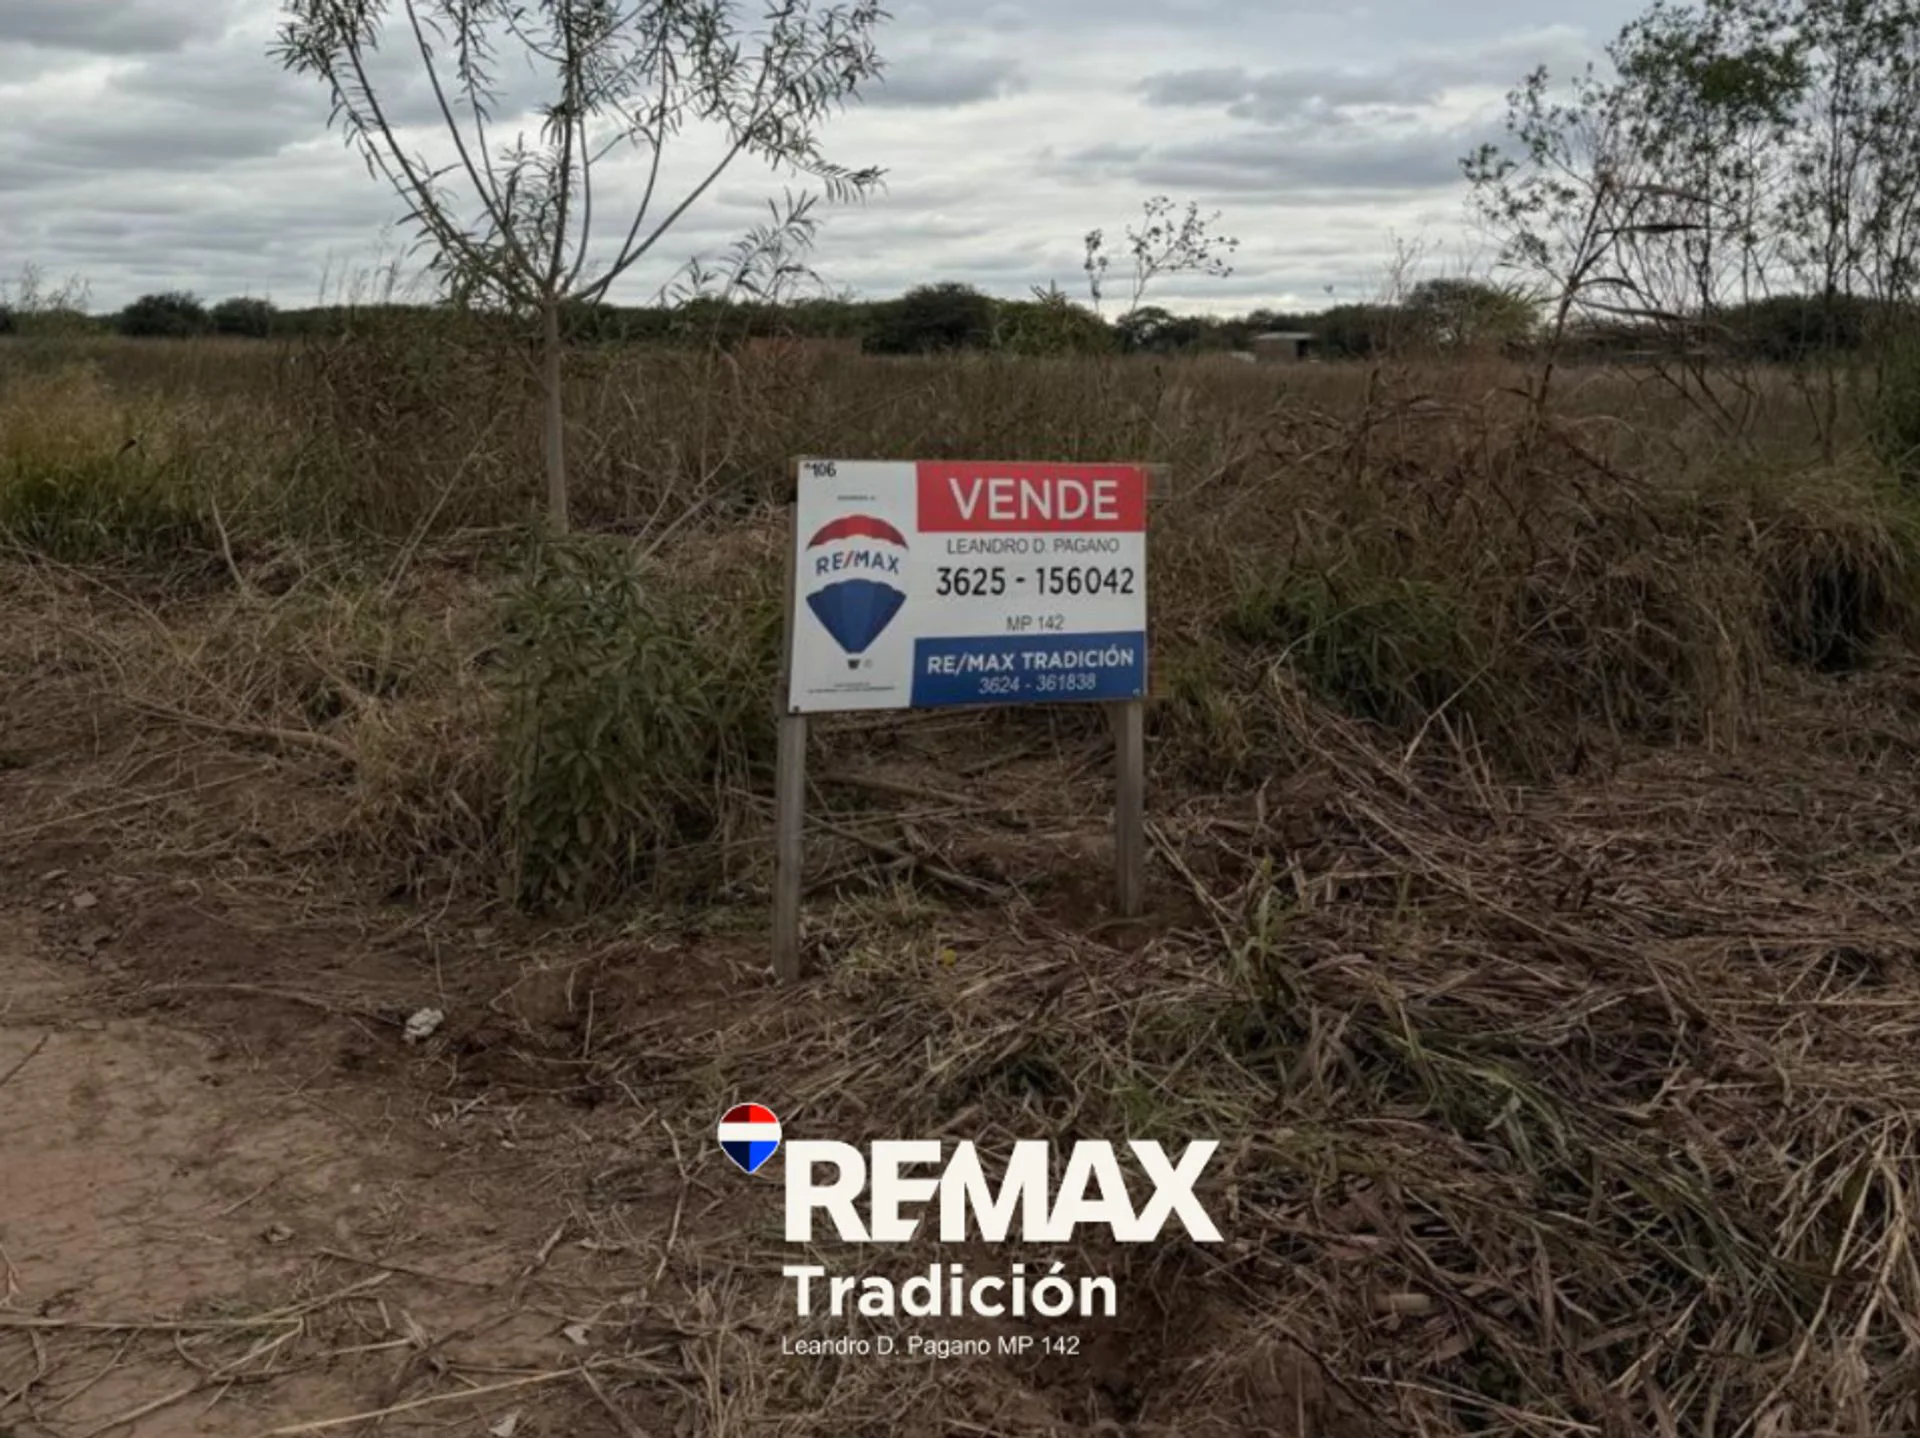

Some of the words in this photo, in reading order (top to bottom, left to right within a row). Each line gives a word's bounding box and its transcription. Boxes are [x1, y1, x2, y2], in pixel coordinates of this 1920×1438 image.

[949, 478, 1119, 520] VENDE
[946, 537, 1029, 554] LEANDRO
[1053, 538, 1120, 554] PAGANO
[815, 550, 900, 576] RE/MAX
[936, 567, 1005, 596] 3625
[1036, 566, 1135, 595] 156042
[1006, 615, 1032, 632] MP
[1037, 614, 1065, 631] 142
[927, 652, 1014, 676] RE/MAX
[1021, 643, 1134, 670] TRADICIÓN
[978, 676, 1020, 695] 3624
[1035, 673, 1096, 692] 361838
